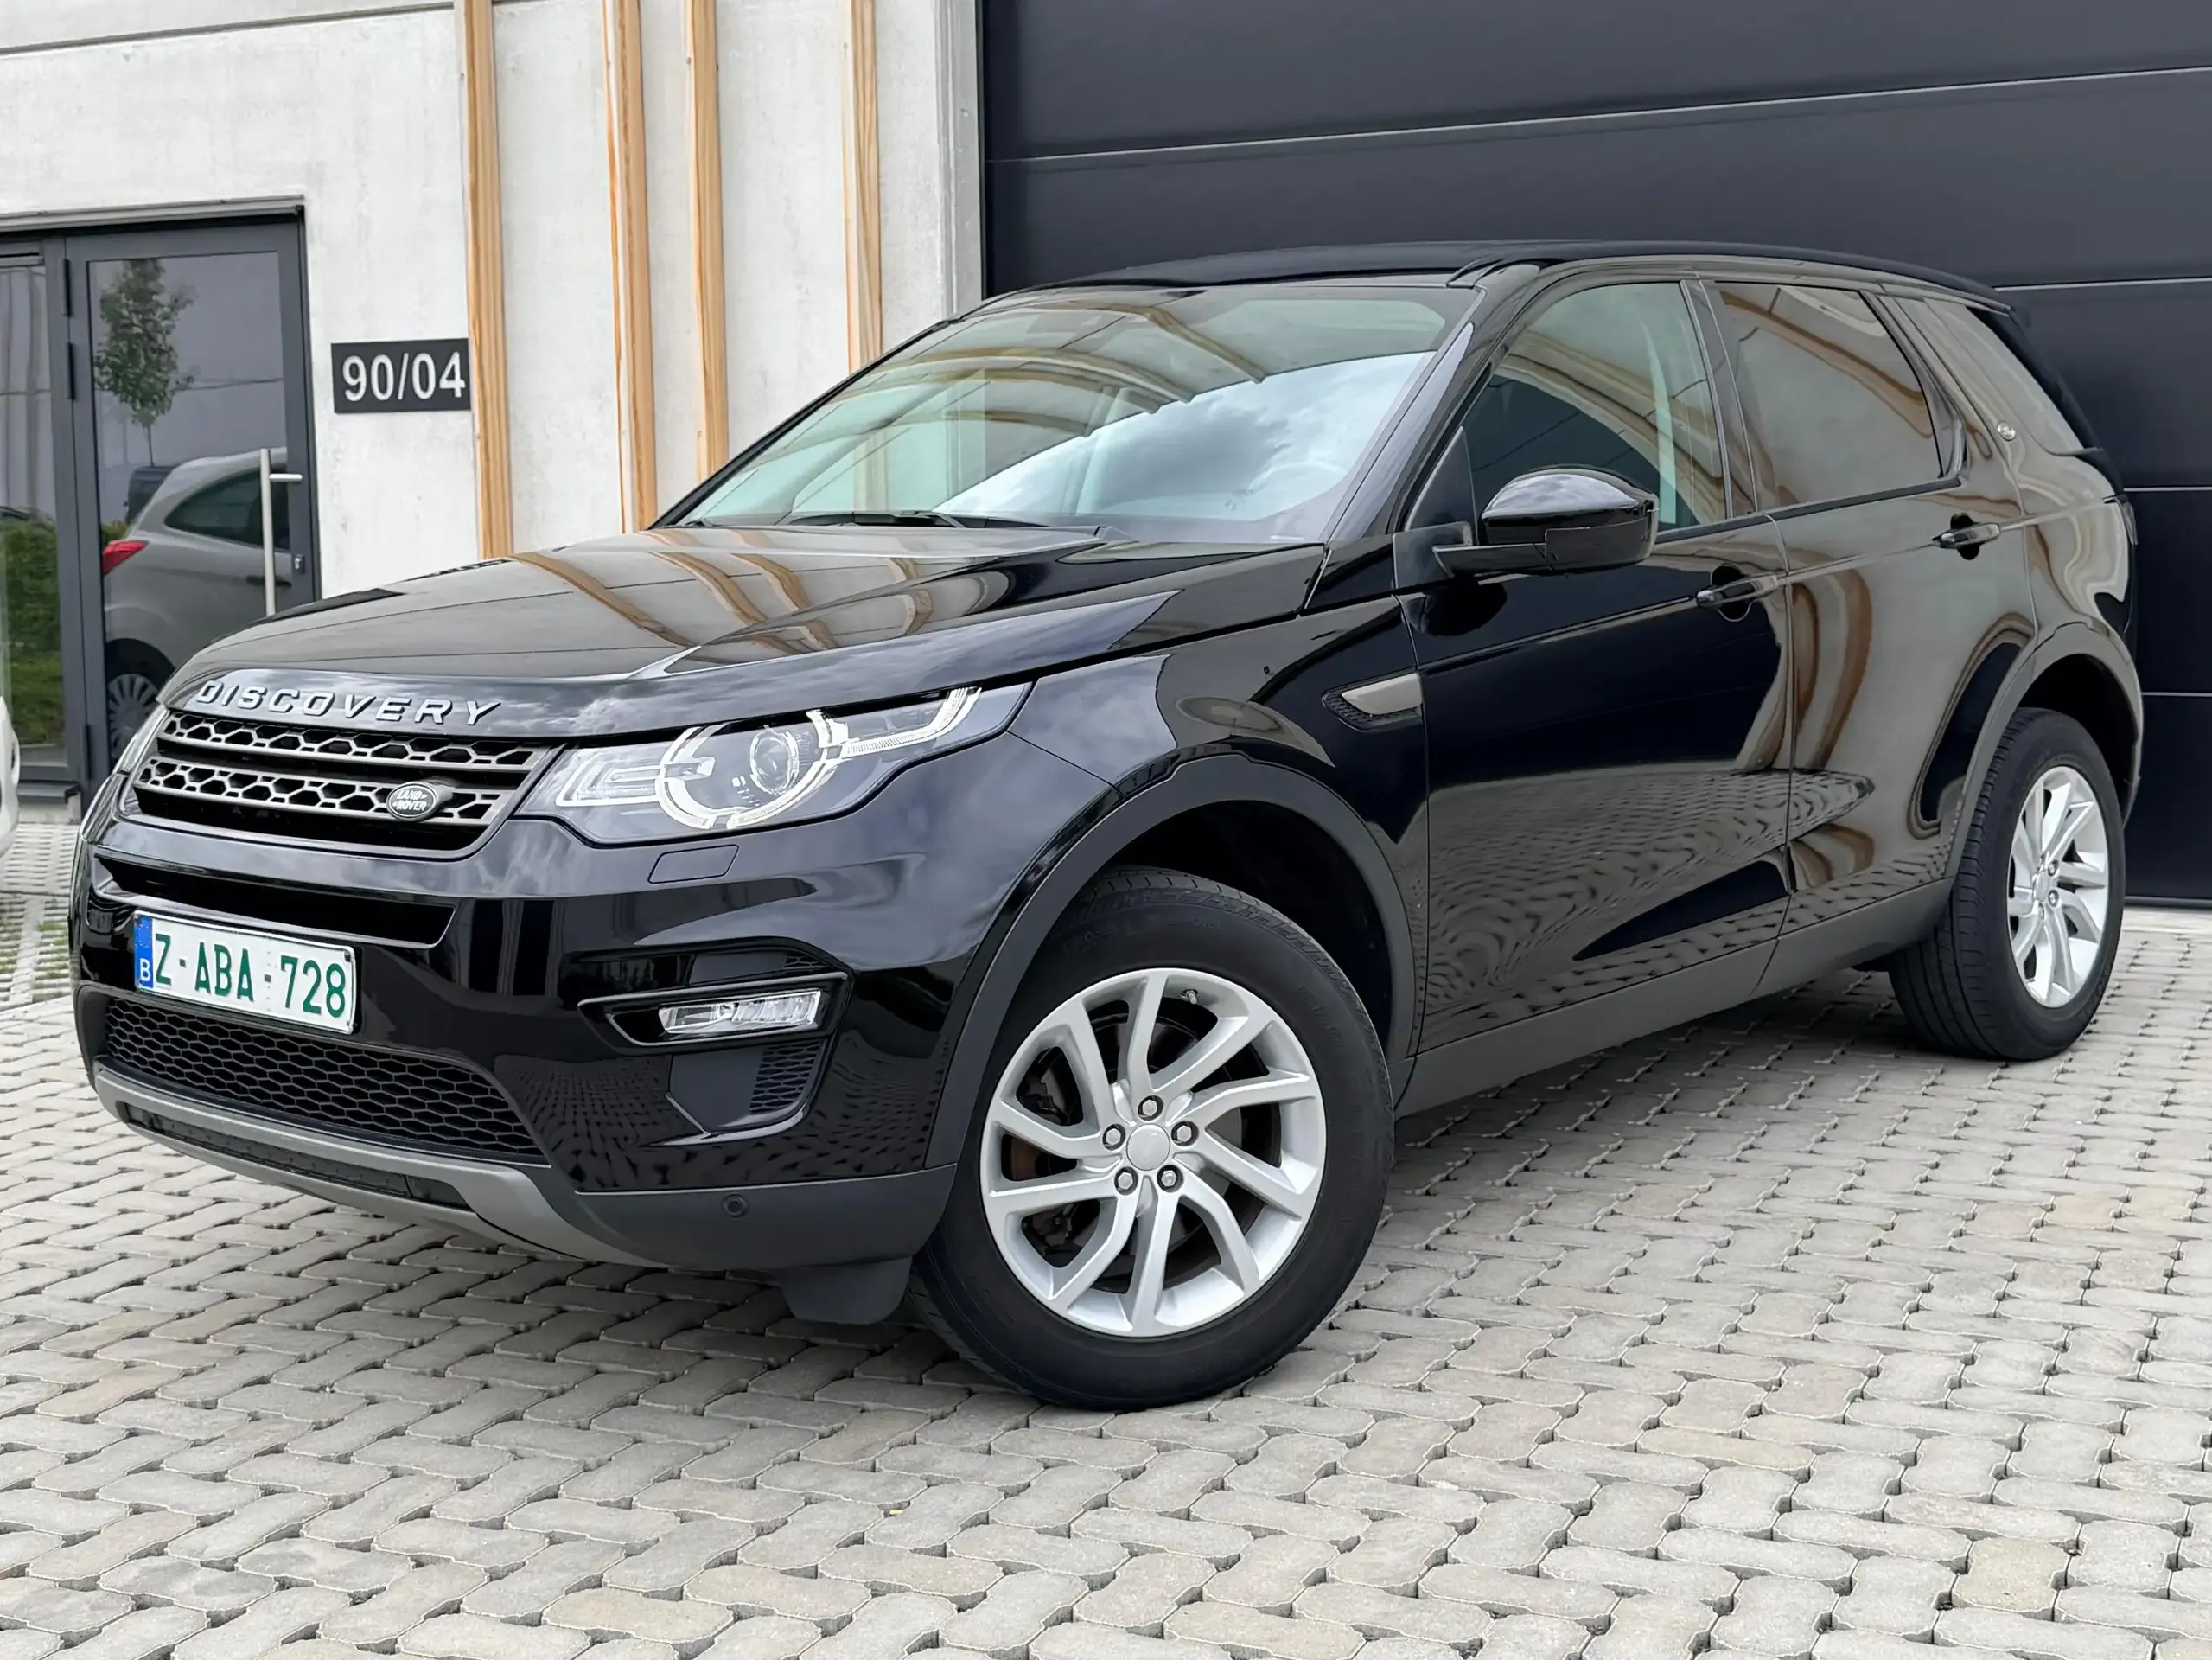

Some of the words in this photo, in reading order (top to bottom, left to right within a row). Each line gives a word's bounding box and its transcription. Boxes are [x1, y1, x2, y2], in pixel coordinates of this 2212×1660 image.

[342, 352, 466, 402] 90/04
[195, 680, 502, 726] DISCOVERY
[396, 789, 423, 801] LAND
[396, 800, 427, 811] ROVER
[139, 958, 150, 982] B
